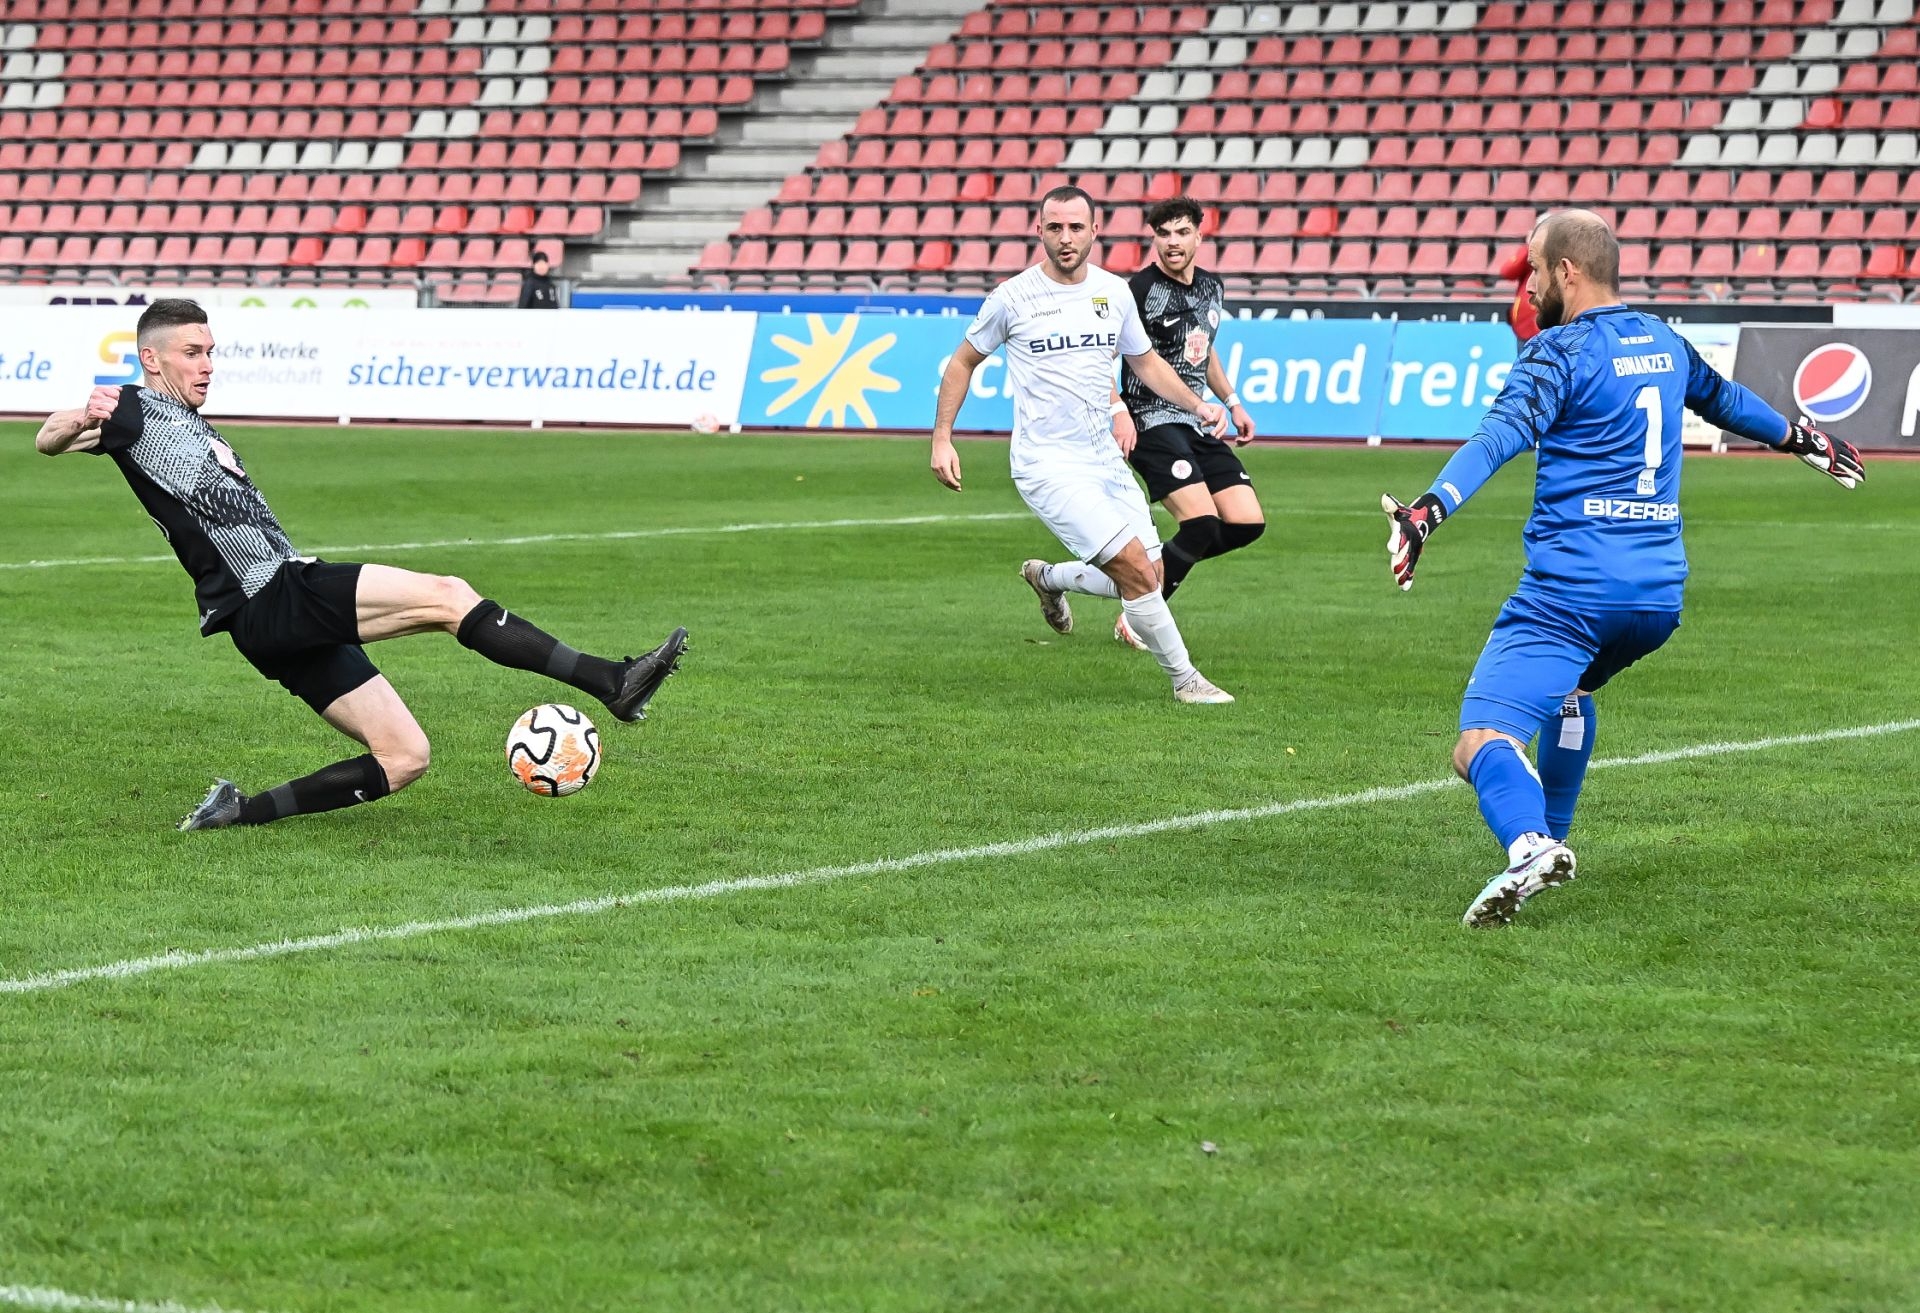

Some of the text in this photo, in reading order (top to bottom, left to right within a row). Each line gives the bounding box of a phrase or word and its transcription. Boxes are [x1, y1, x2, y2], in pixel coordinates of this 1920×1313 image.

[261, 342, 319, 359] Werke
[1029, 332, 1115, 353] SÜLZLE
[348, 356, 717, 391] sicher-verwandelt.de
[1612, 352, 1676, 377] BINANZER
[1635, 386, 1663, 495] 1
